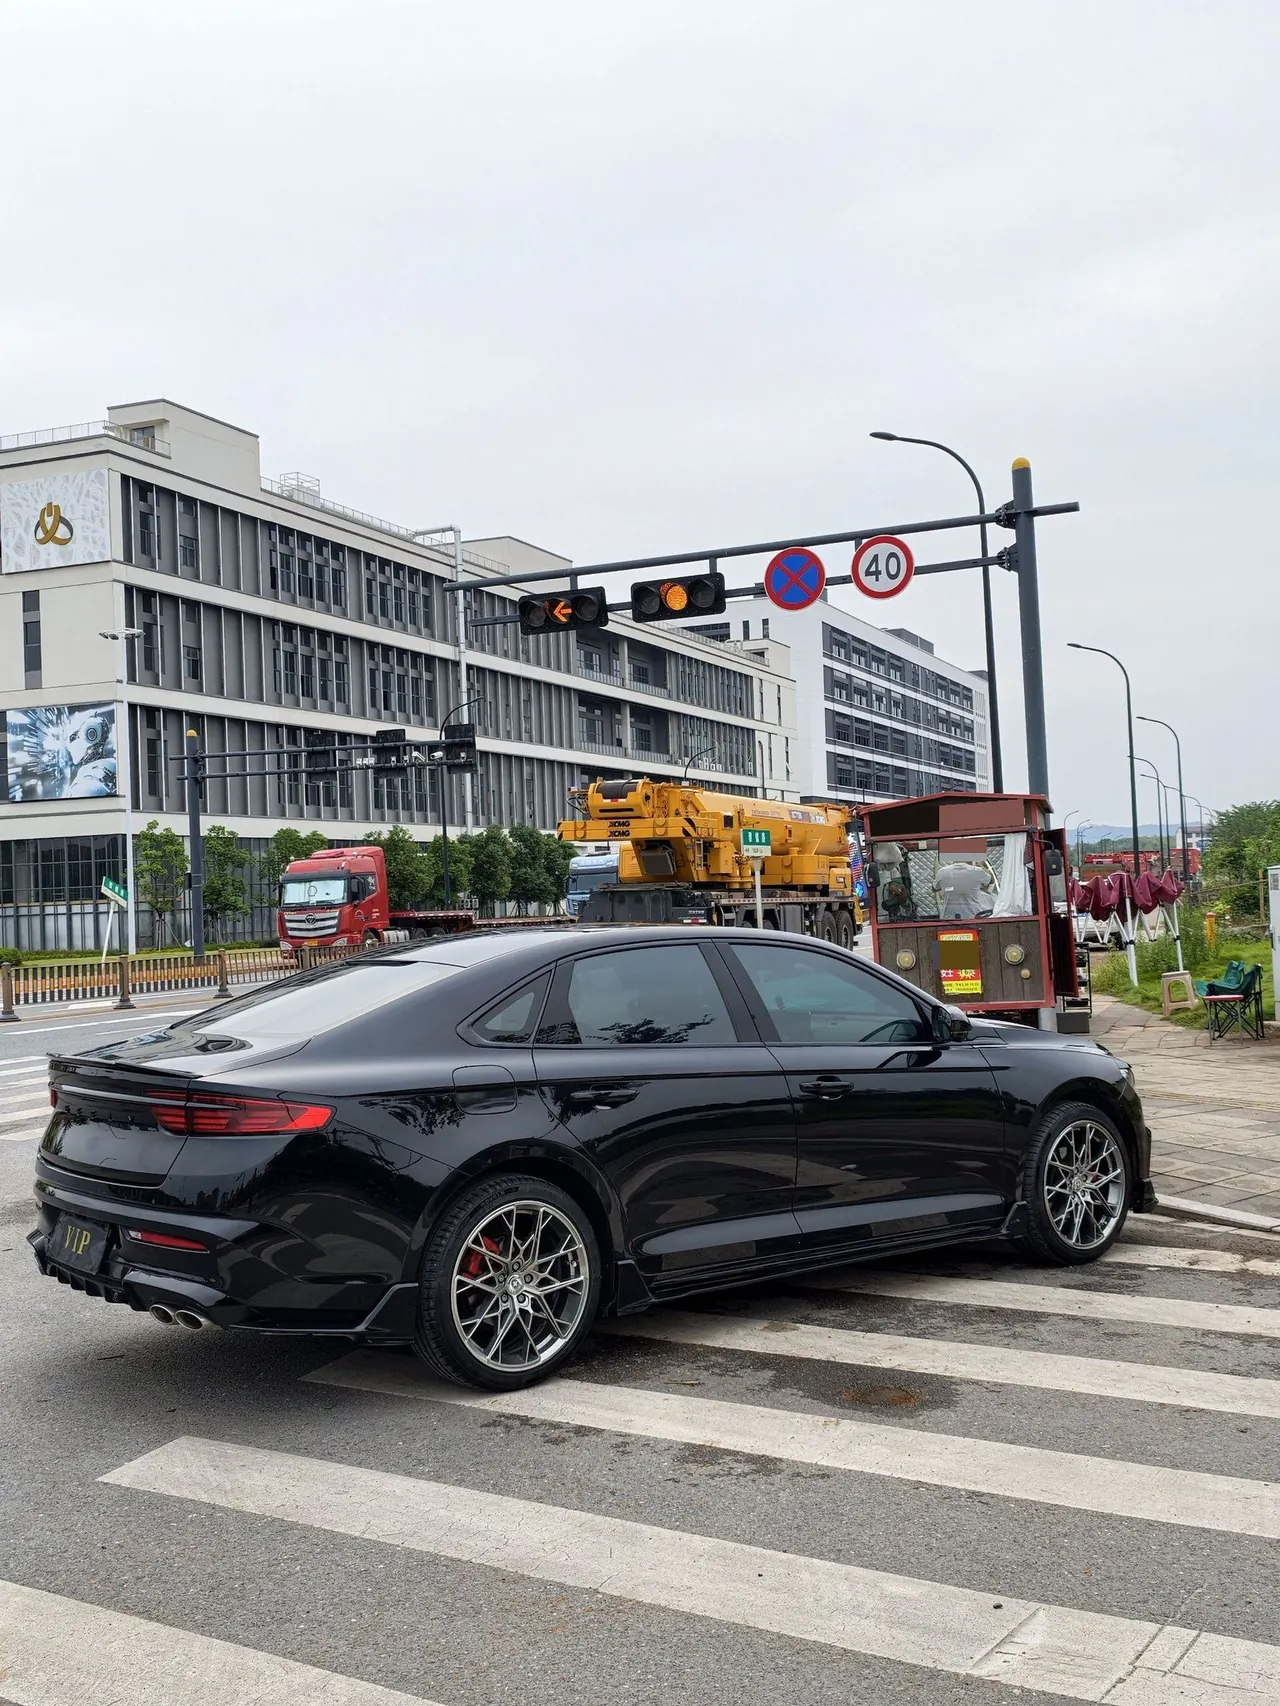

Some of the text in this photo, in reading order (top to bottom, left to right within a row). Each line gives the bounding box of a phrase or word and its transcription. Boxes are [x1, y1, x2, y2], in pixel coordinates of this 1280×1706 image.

[864, 551, 901, 582] 40
[607, 820, 631, 828] XCMG
[607, 829, 631, 838] XCMG
[64, 1225, 91, 1255] VIP
